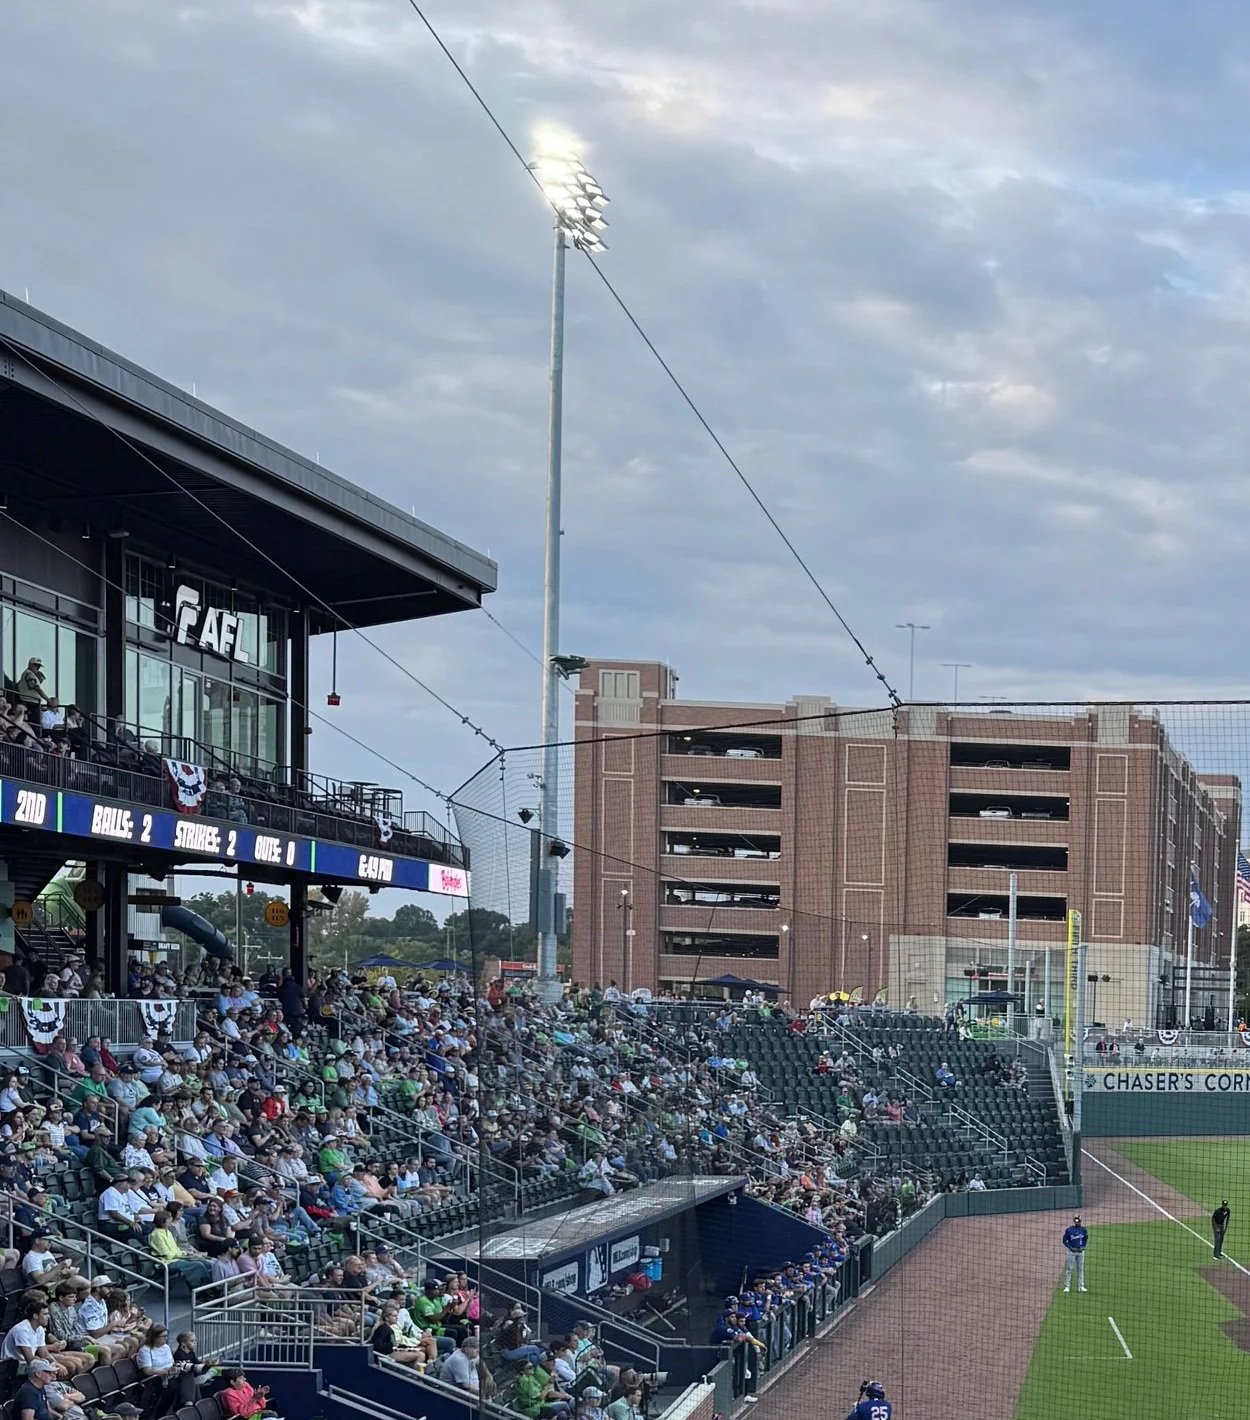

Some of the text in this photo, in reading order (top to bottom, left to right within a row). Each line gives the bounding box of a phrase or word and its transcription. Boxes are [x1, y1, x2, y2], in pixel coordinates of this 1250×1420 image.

[199, 606, 249, 663] AFL
[15, 790, 46, 824] 2ND
[92, 804, 152, 842] BALLS: 2
[174, 820, 237, 856] STRIKES: 2
[254, 835, 295, 866] OUTS: 0
[1103, 1072, 1194, 1091] CHASER'S
[871, 1406, 888, 1420] 25
